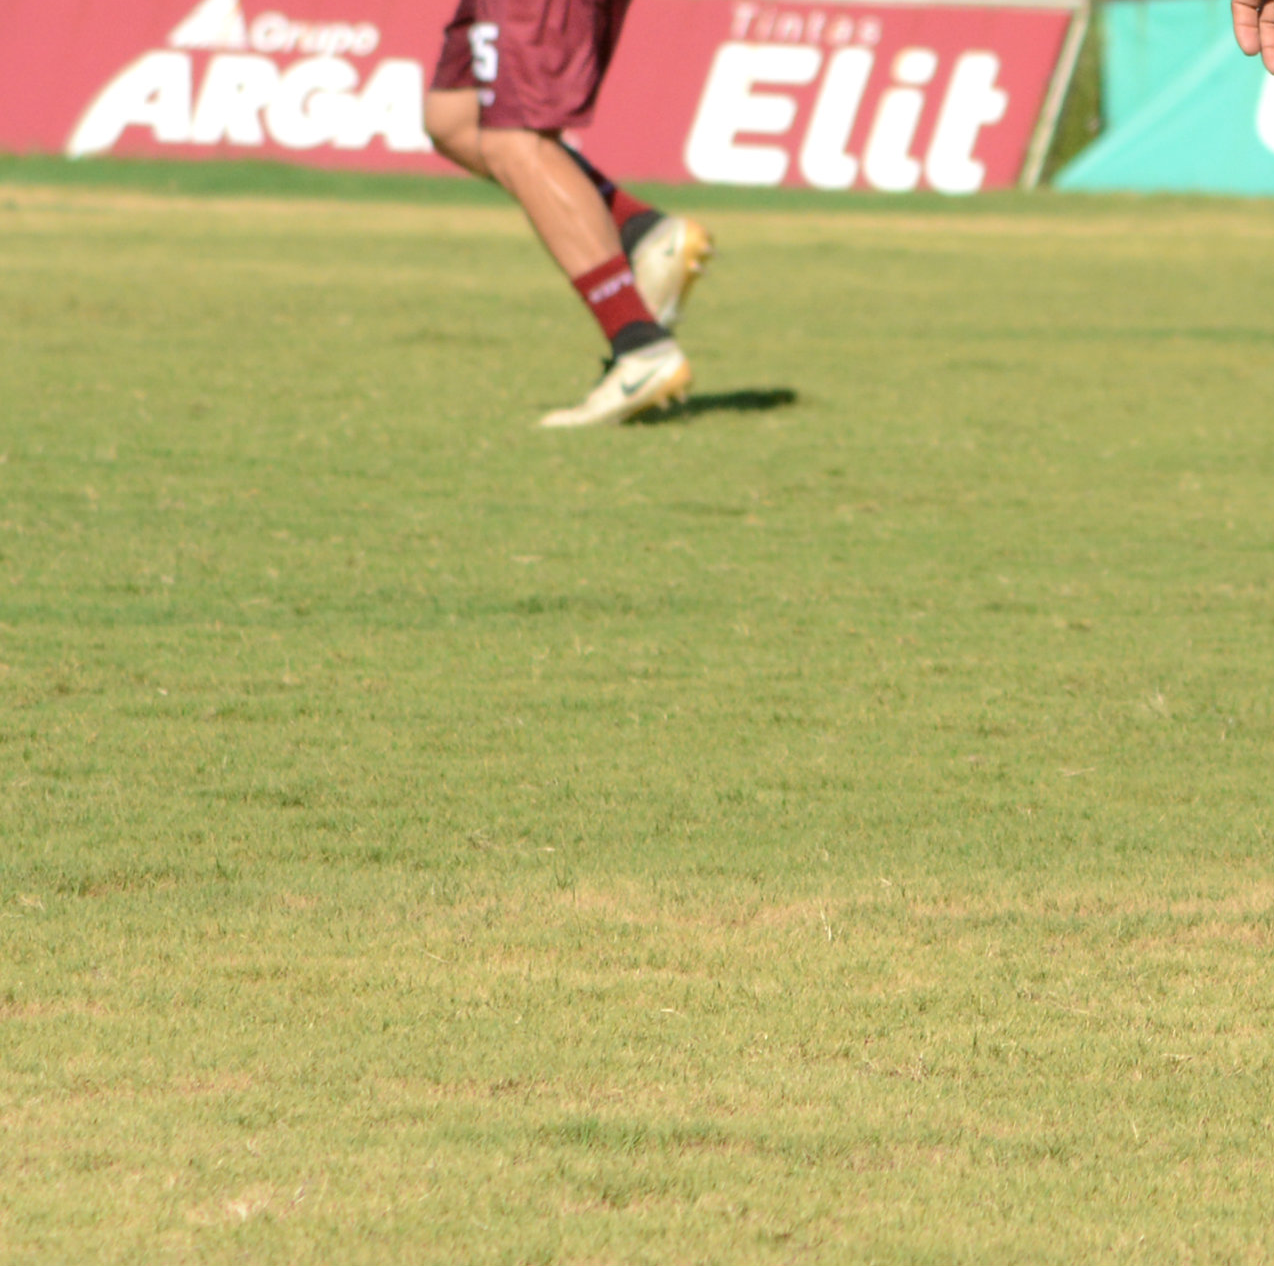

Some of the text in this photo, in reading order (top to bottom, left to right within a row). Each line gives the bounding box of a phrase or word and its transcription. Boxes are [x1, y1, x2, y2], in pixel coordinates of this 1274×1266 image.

[250, 12, 380, 57] Grupo
[730, 3, 883, 47] Tintas
[66, 48, 431, 161] ARGA
[683, 42, 1008, 195] Elit
